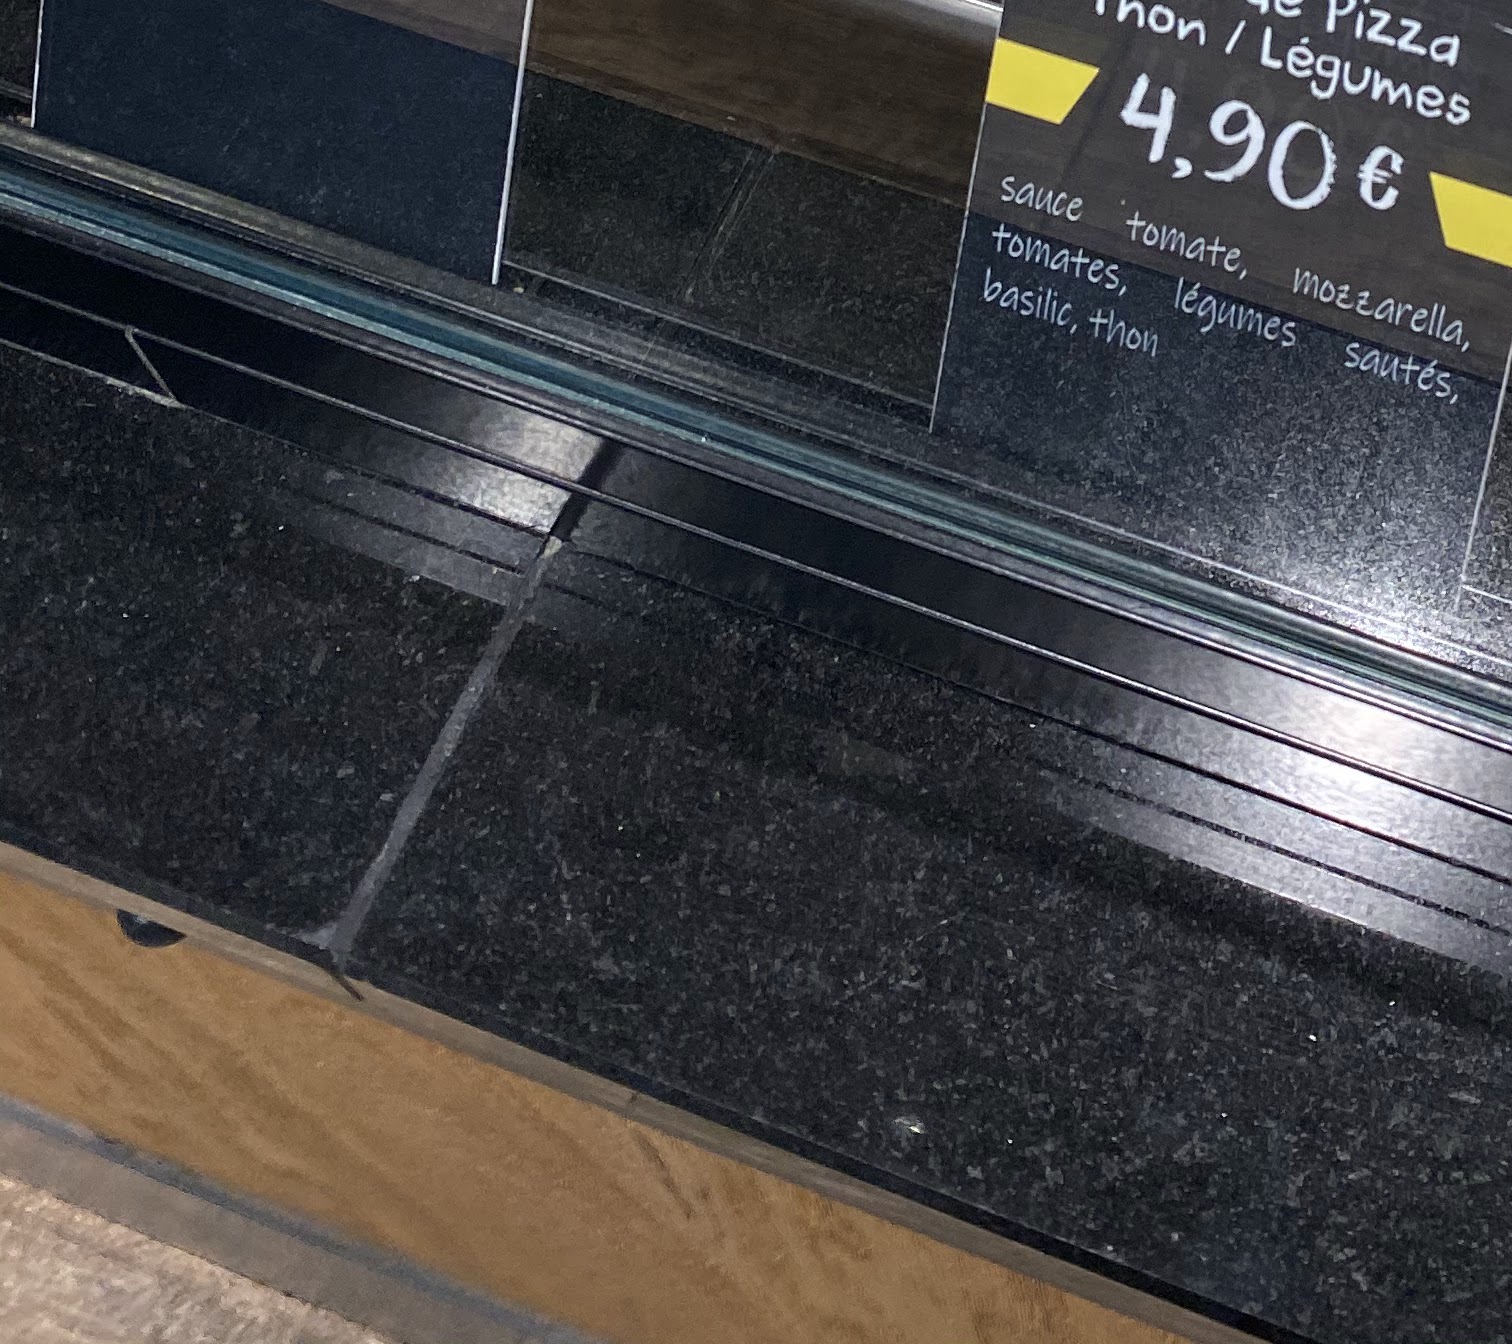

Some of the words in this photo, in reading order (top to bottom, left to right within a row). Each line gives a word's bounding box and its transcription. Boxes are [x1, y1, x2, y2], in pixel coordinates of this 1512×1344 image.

[1223, 19, 1246, 55] /
[1259, 28, 1472, 126] Légumes
[983, 268, 1077, 335] basilic,
[1089, 308, 1160, 357] thon
[992, 223, 1128, 296] tomates,
[1174, 276, 1298, 347] légumes
[1344, 341, 1459, 404] sautés,
[1001, 175, 1083, 222] sauce
[1126, 211, 1247, 280] tomate,
[1293, 268, 1471, 352] mozzarella,
